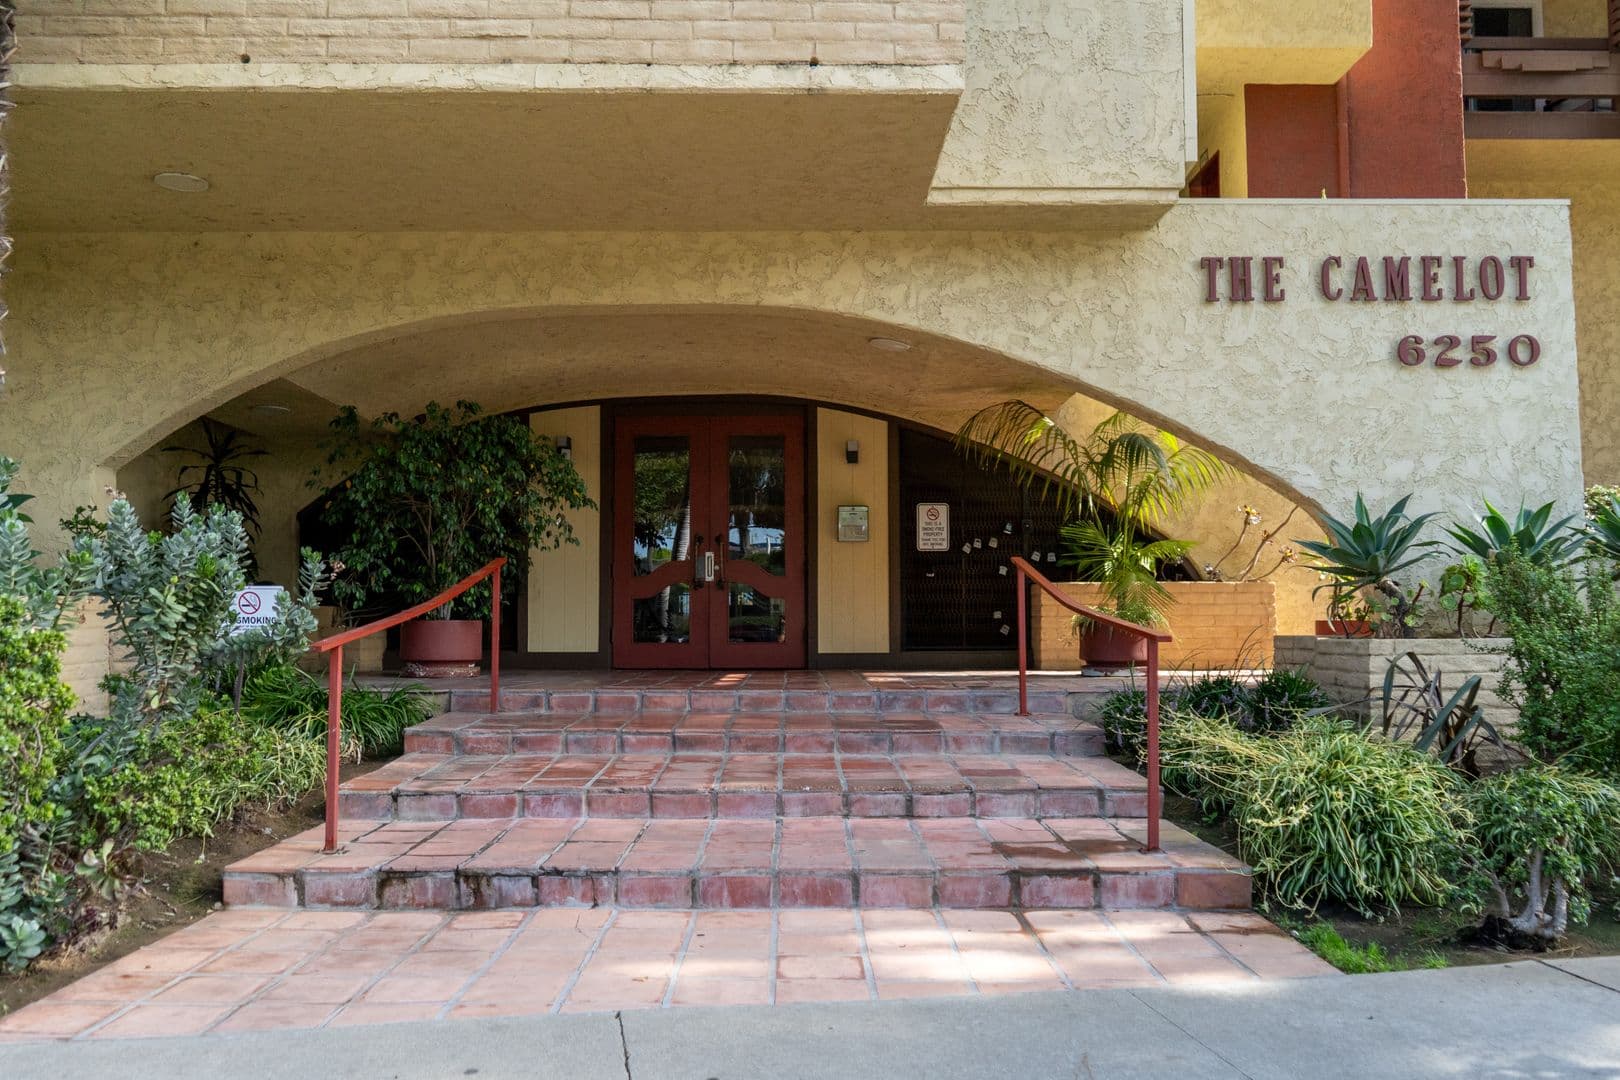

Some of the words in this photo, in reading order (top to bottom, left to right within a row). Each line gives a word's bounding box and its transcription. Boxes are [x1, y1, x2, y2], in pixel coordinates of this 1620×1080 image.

[1200, 256, 1286, 302] THE
[1320, 255, 1535, 302] CAMELOT
[1398, 334, 1541, 367] 6250
[237, 616, 277, 624] SMOKING
